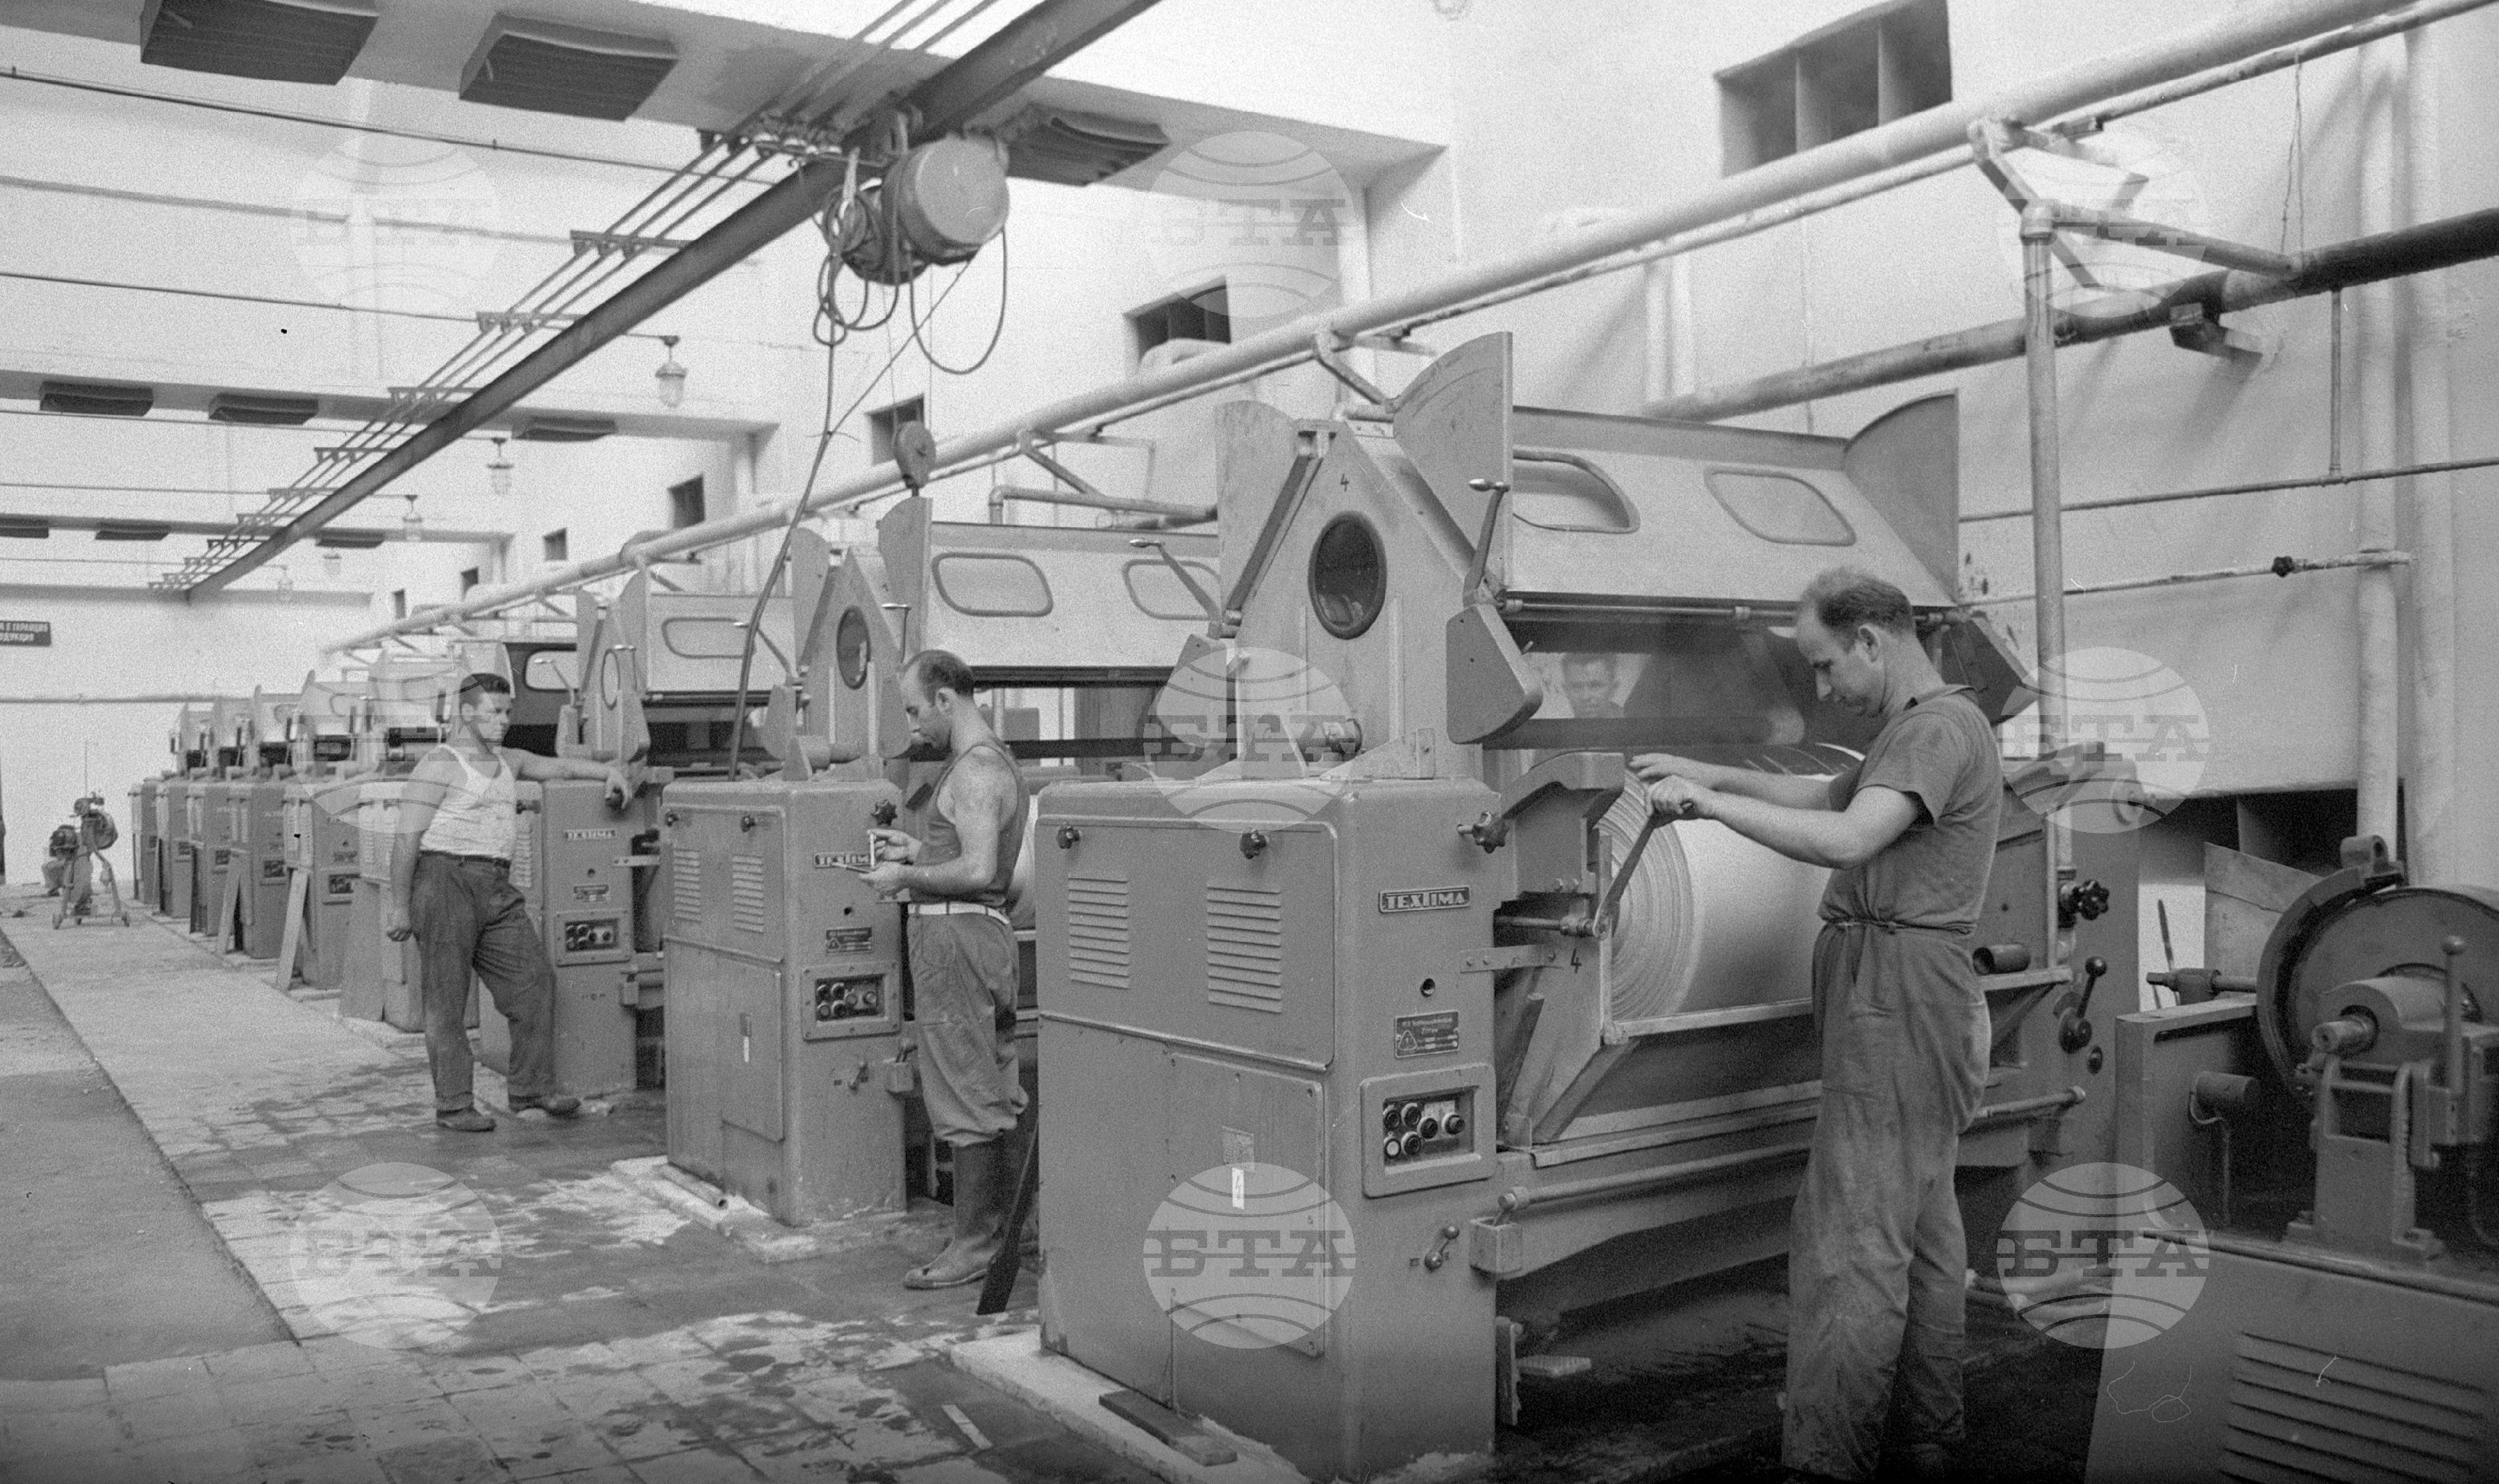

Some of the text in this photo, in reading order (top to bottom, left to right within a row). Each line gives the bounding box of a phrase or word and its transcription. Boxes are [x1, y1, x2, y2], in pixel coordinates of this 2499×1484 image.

[1339, 473, 1349, 492] 4
[1386, 891, 1466, 910] TEXTIMA
[1571, 948, 1582, 974] 4
